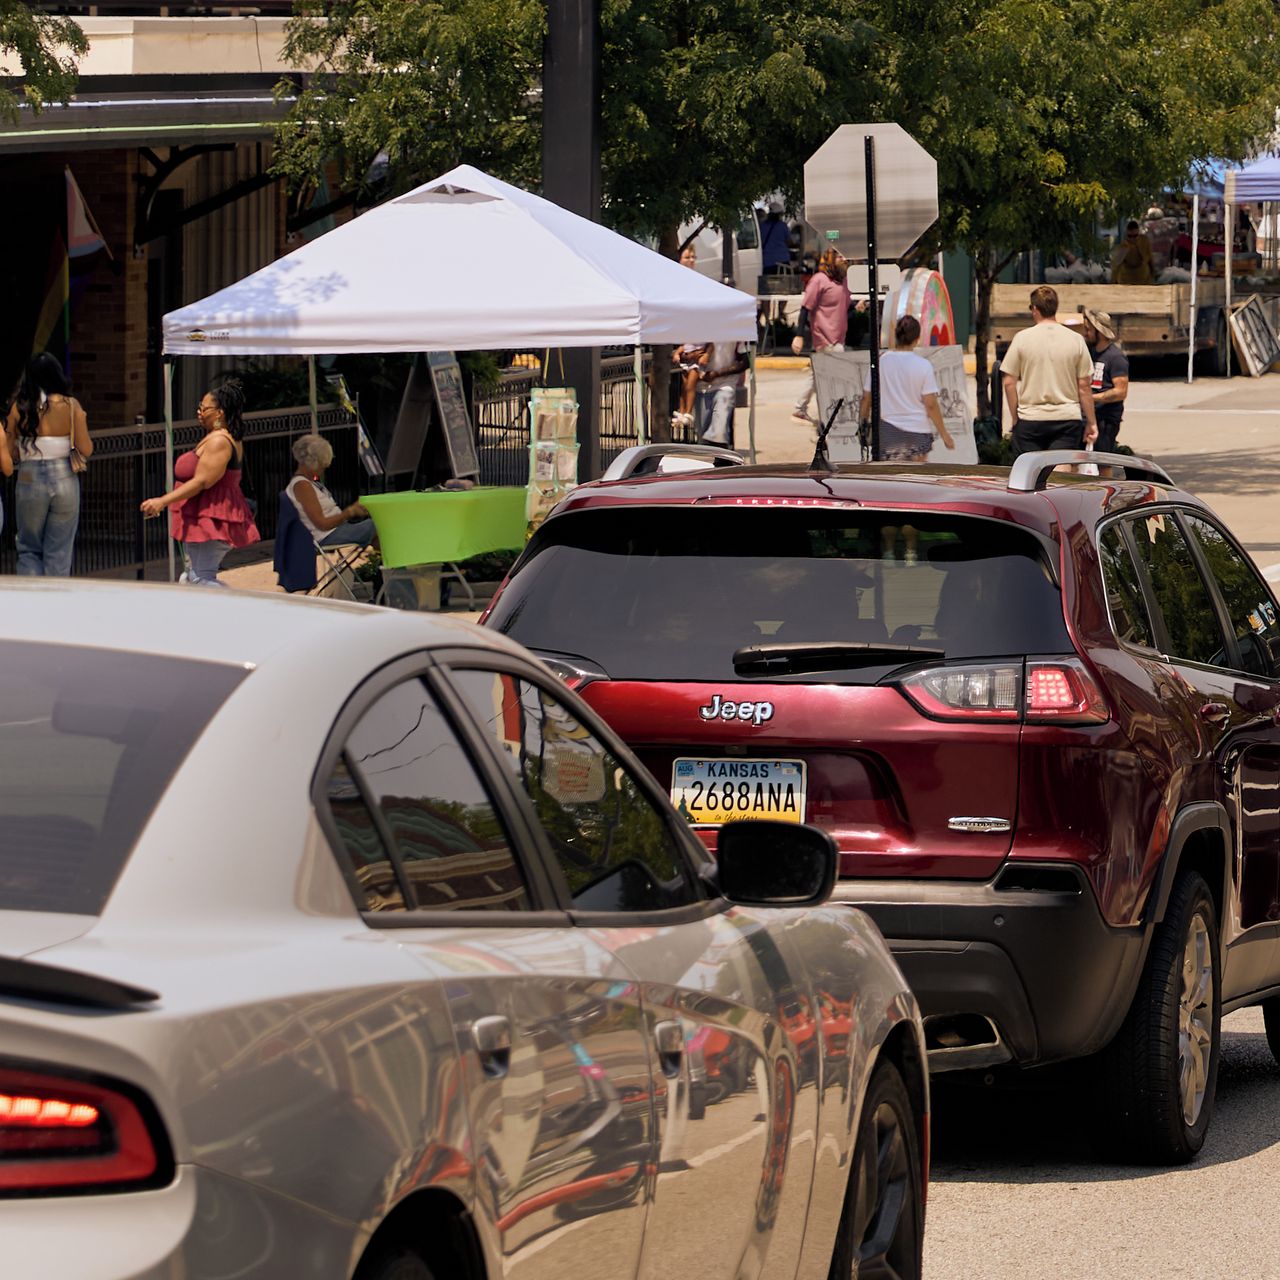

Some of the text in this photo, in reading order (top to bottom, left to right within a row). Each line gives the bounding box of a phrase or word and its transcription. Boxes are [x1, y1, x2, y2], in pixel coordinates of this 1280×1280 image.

[700, 695, 774, 725] Jeep
[707, 762, 769, 778] KANSAS
[690, 780, 796, 813] 2688ANA
